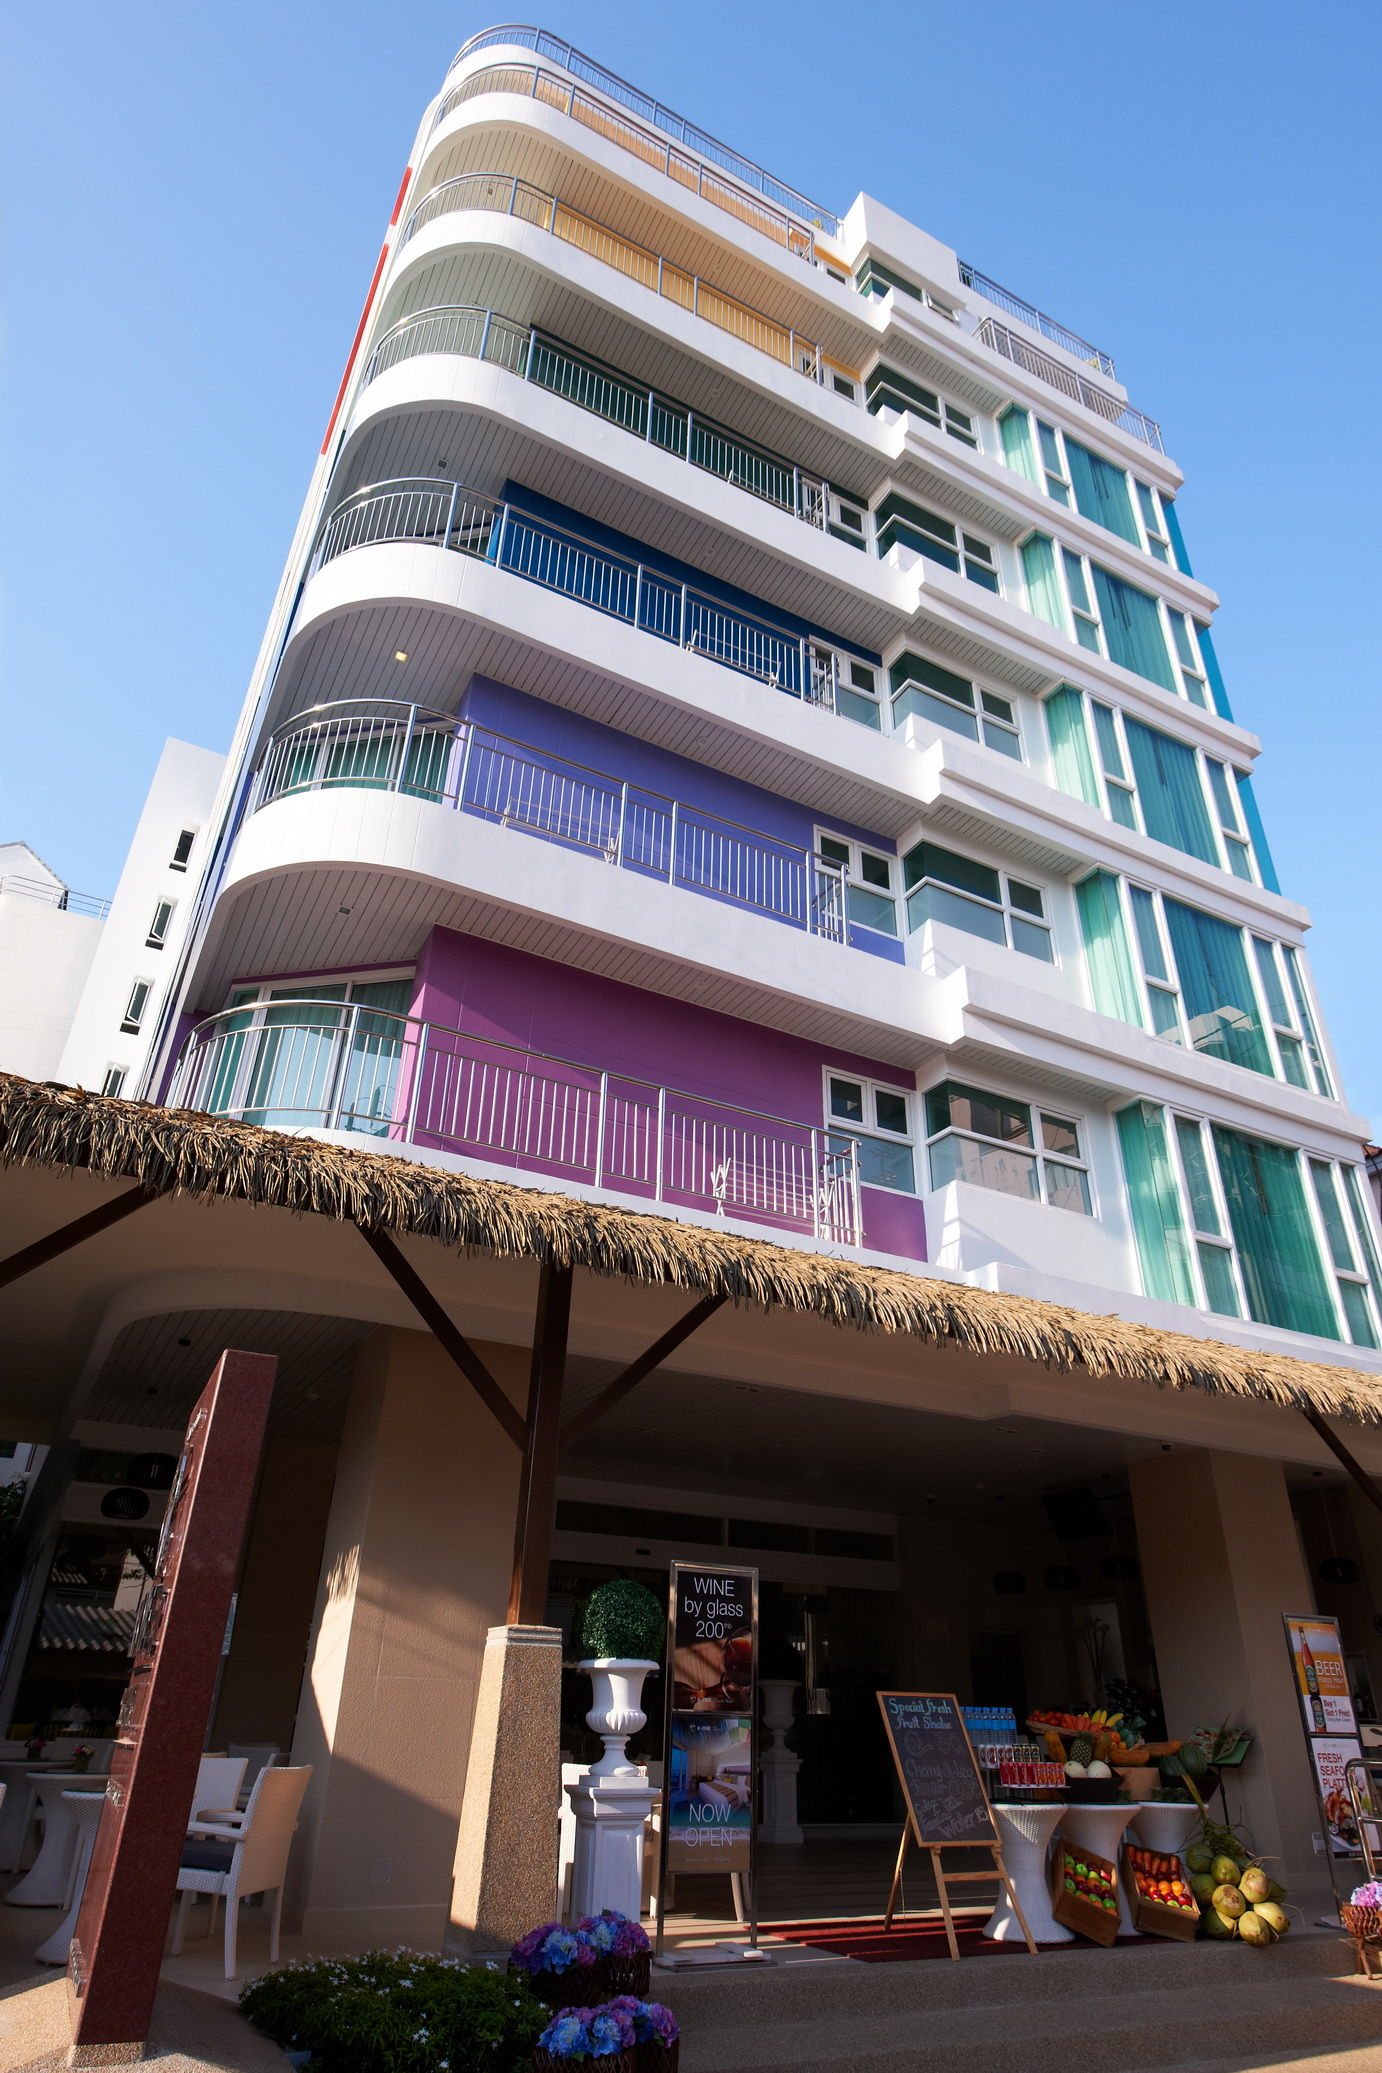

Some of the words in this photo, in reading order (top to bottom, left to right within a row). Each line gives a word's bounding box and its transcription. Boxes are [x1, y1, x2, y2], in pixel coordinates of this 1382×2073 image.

[693, 1577, 735, 1596] WINE
[684, 1595, 702, 1617] by
[706, 1598, 744, 1619] glass
[1315, 1660, 1344, 1676] BEER
[888, 1698, 925, 1717] Special
[1317, 1753, 1343, 1763] FRESH
[1320, 1765, 1350, 1776] SEAFO
[689, 1803, 731, 1823] NOW
[685, 1827, 733, 1847] OPEN
